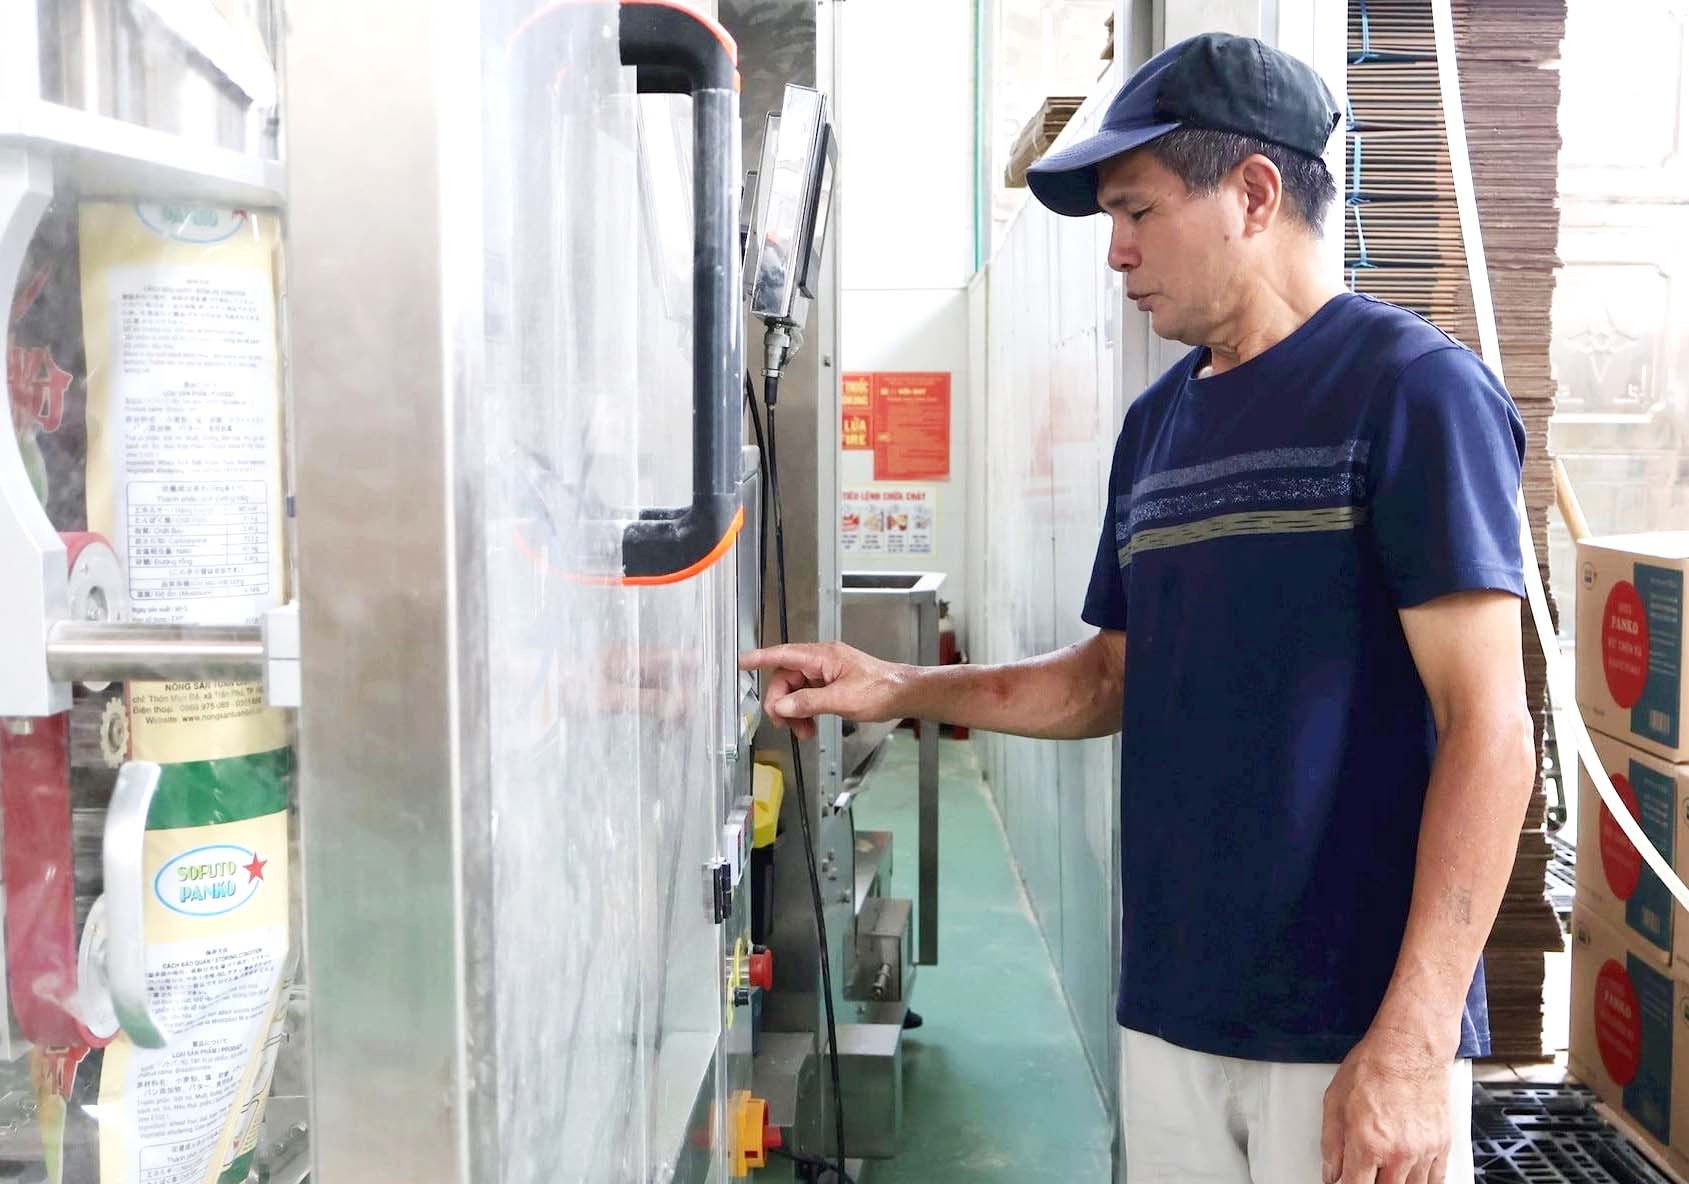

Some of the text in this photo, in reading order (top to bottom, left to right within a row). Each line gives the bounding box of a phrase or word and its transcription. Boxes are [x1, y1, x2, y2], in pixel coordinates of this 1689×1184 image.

[1611, 614, 1639, 636] PANKO
[177, 860, 237, 882] SOFUTO
[180, 879, 237, 903] PANKO
